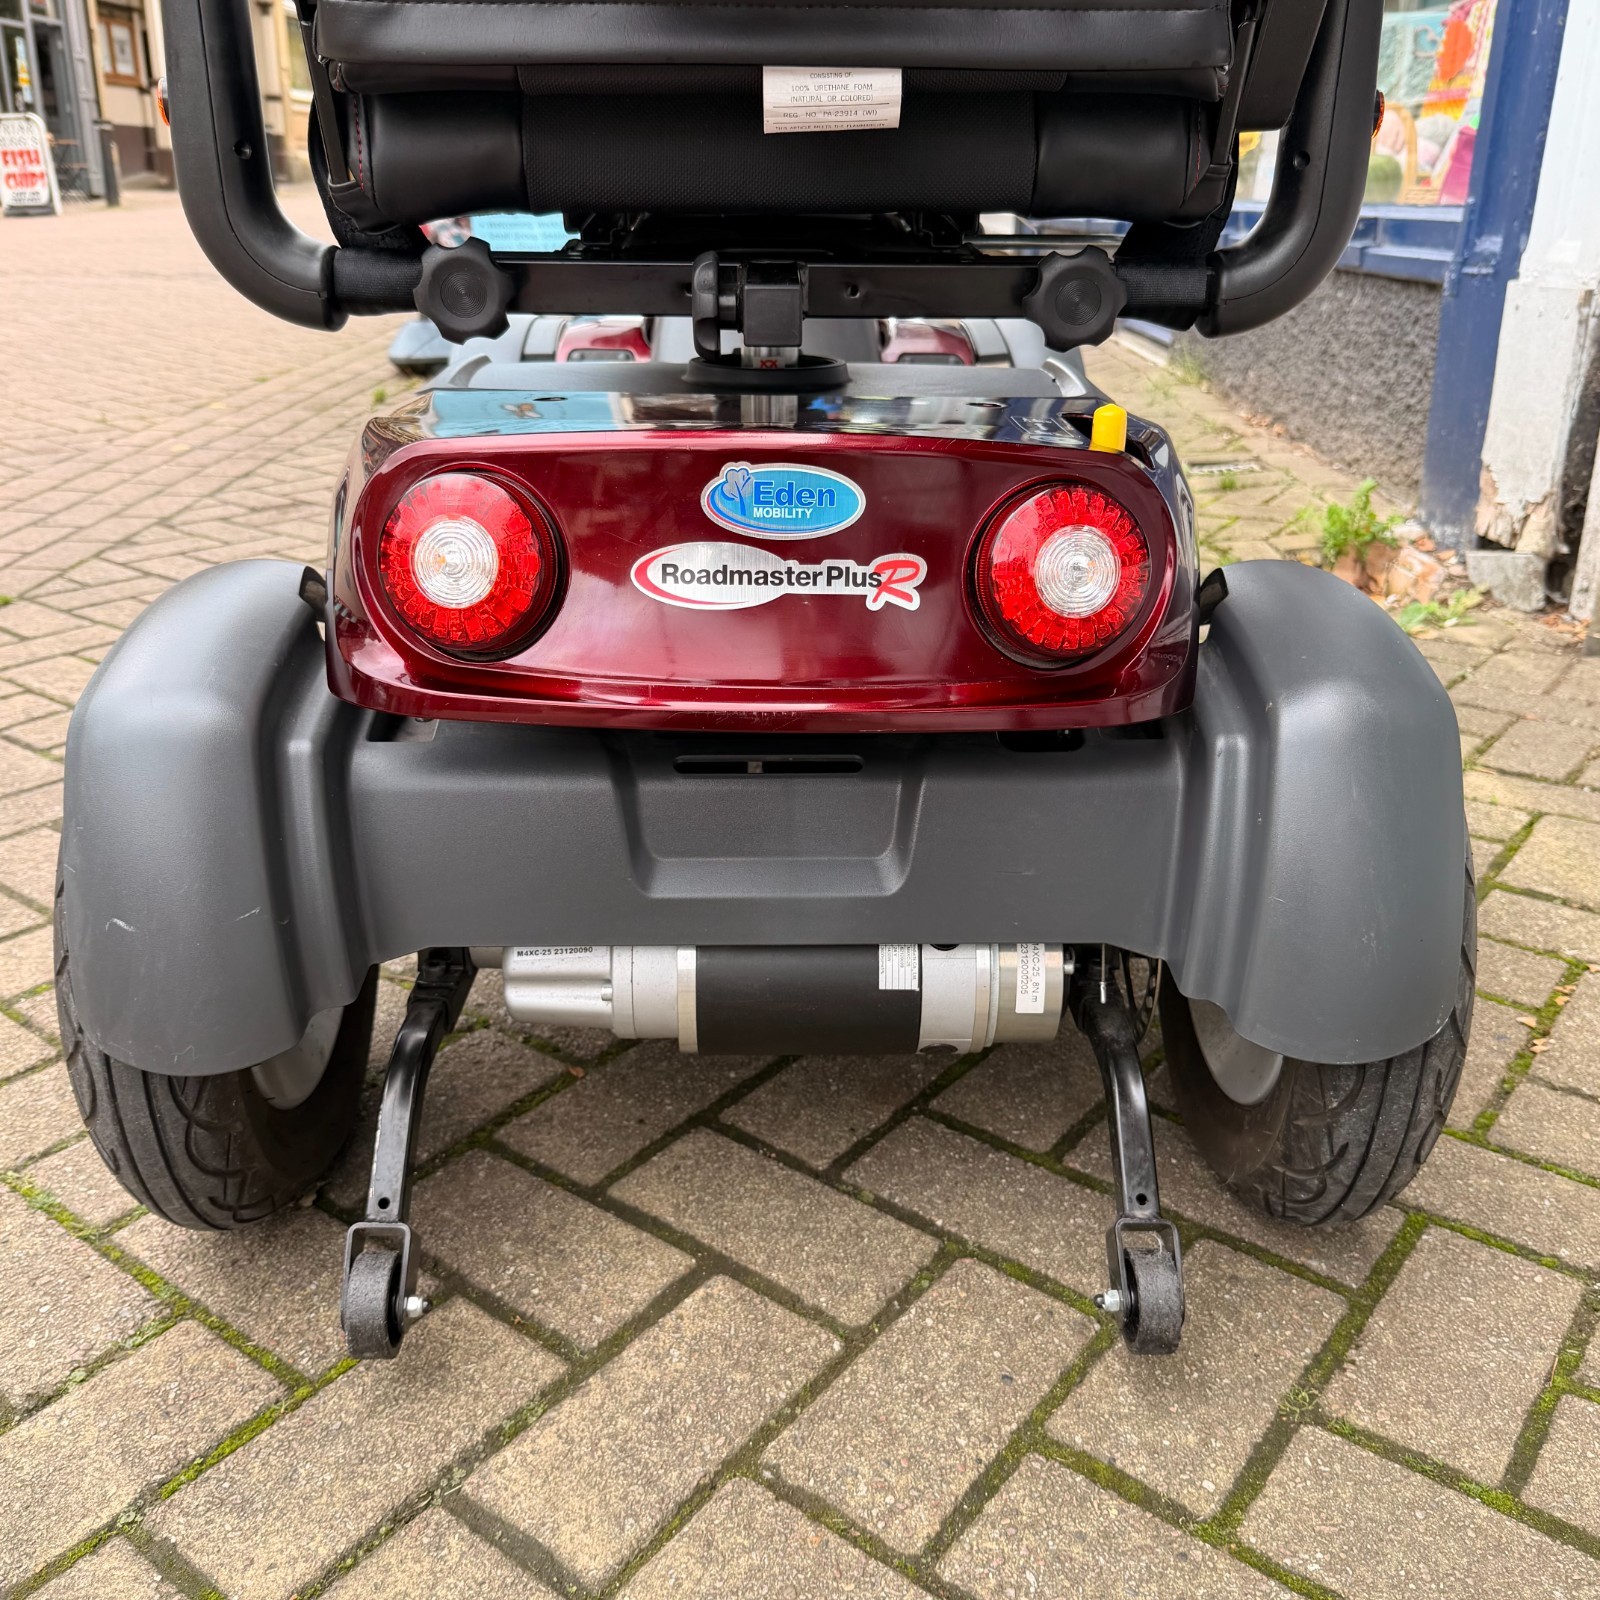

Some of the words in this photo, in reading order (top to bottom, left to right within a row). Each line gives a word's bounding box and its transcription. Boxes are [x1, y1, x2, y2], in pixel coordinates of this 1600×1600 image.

[814, 84, 850, 92] URETHANE
[854, 83, 873, 91] FOAM
[790, 95, 823, 103] (NATURAL
[841, 94, 874, 102] COLORED)
[753, 481, 836, 507] Eden
[753, 508, 813, 519] MOBILITY
[517, 949, 552, 957] M4XC-25
[554, 946, 593, 955] 23120090
[1020, 944, 1029, 995] 2312000205
